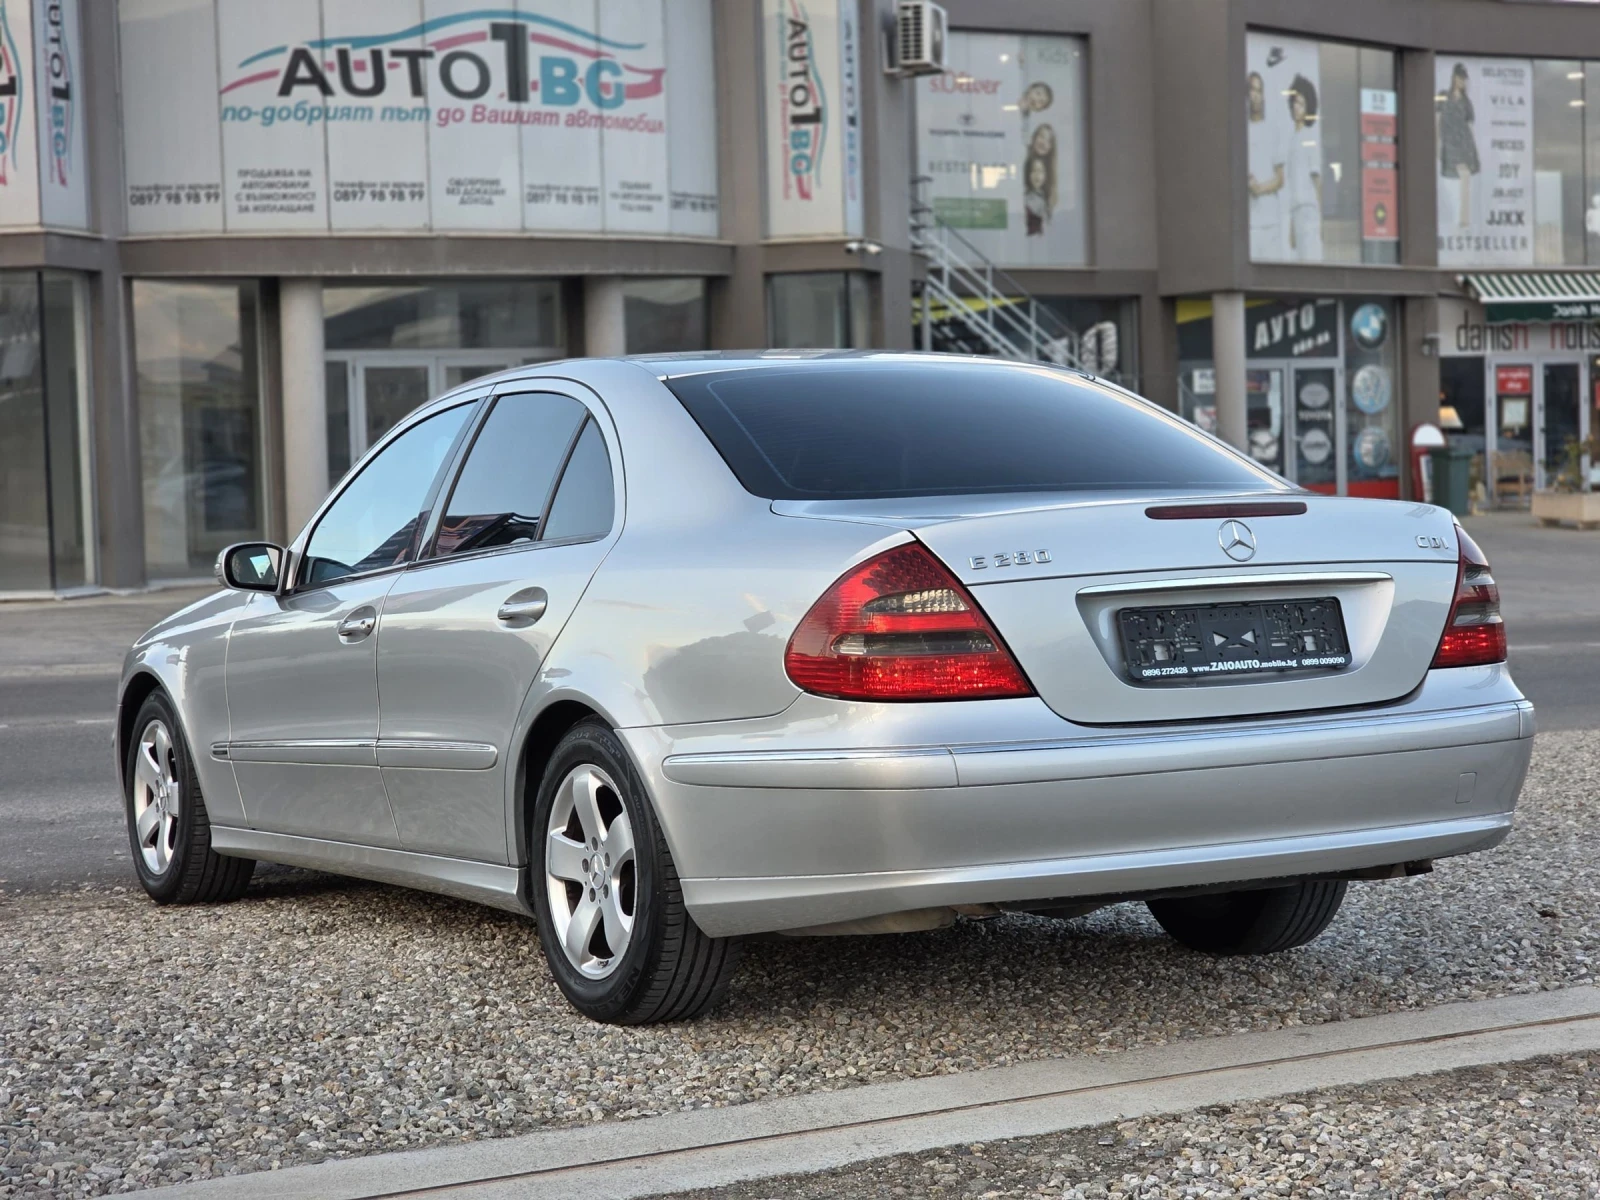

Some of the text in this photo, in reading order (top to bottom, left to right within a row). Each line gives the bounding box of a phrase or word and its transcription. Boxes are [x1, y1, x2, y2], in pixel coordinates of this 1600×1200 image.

[277, 21, 626, 110] AUTO1BG
[47, 0, 70, 158] UTO1BG
[788, 19, 822, 176] AUTO1BG
[1490, 95, 1525, 106] VILA
[222, 100, 666, 134] по-добрият път до Вашият автомобил
[129, 191, 220, 206] 0897 98 98 99
[334, 189, 424, 202] 0897 98 98 99
[1486, 210, 1525, 226] JJXX
[1438, 236, 1528, 251] BESTSELLER
[1415, 535, 1449, 550] CDI
[969, 549, 1052, 570] E 280
[1142, 668, 1160, 677] 0896
[1161, 667, 1188, 676] 272428
[1302, 658, 1319, 666] 0899
[1320, 656, 1345, 665] 009090
